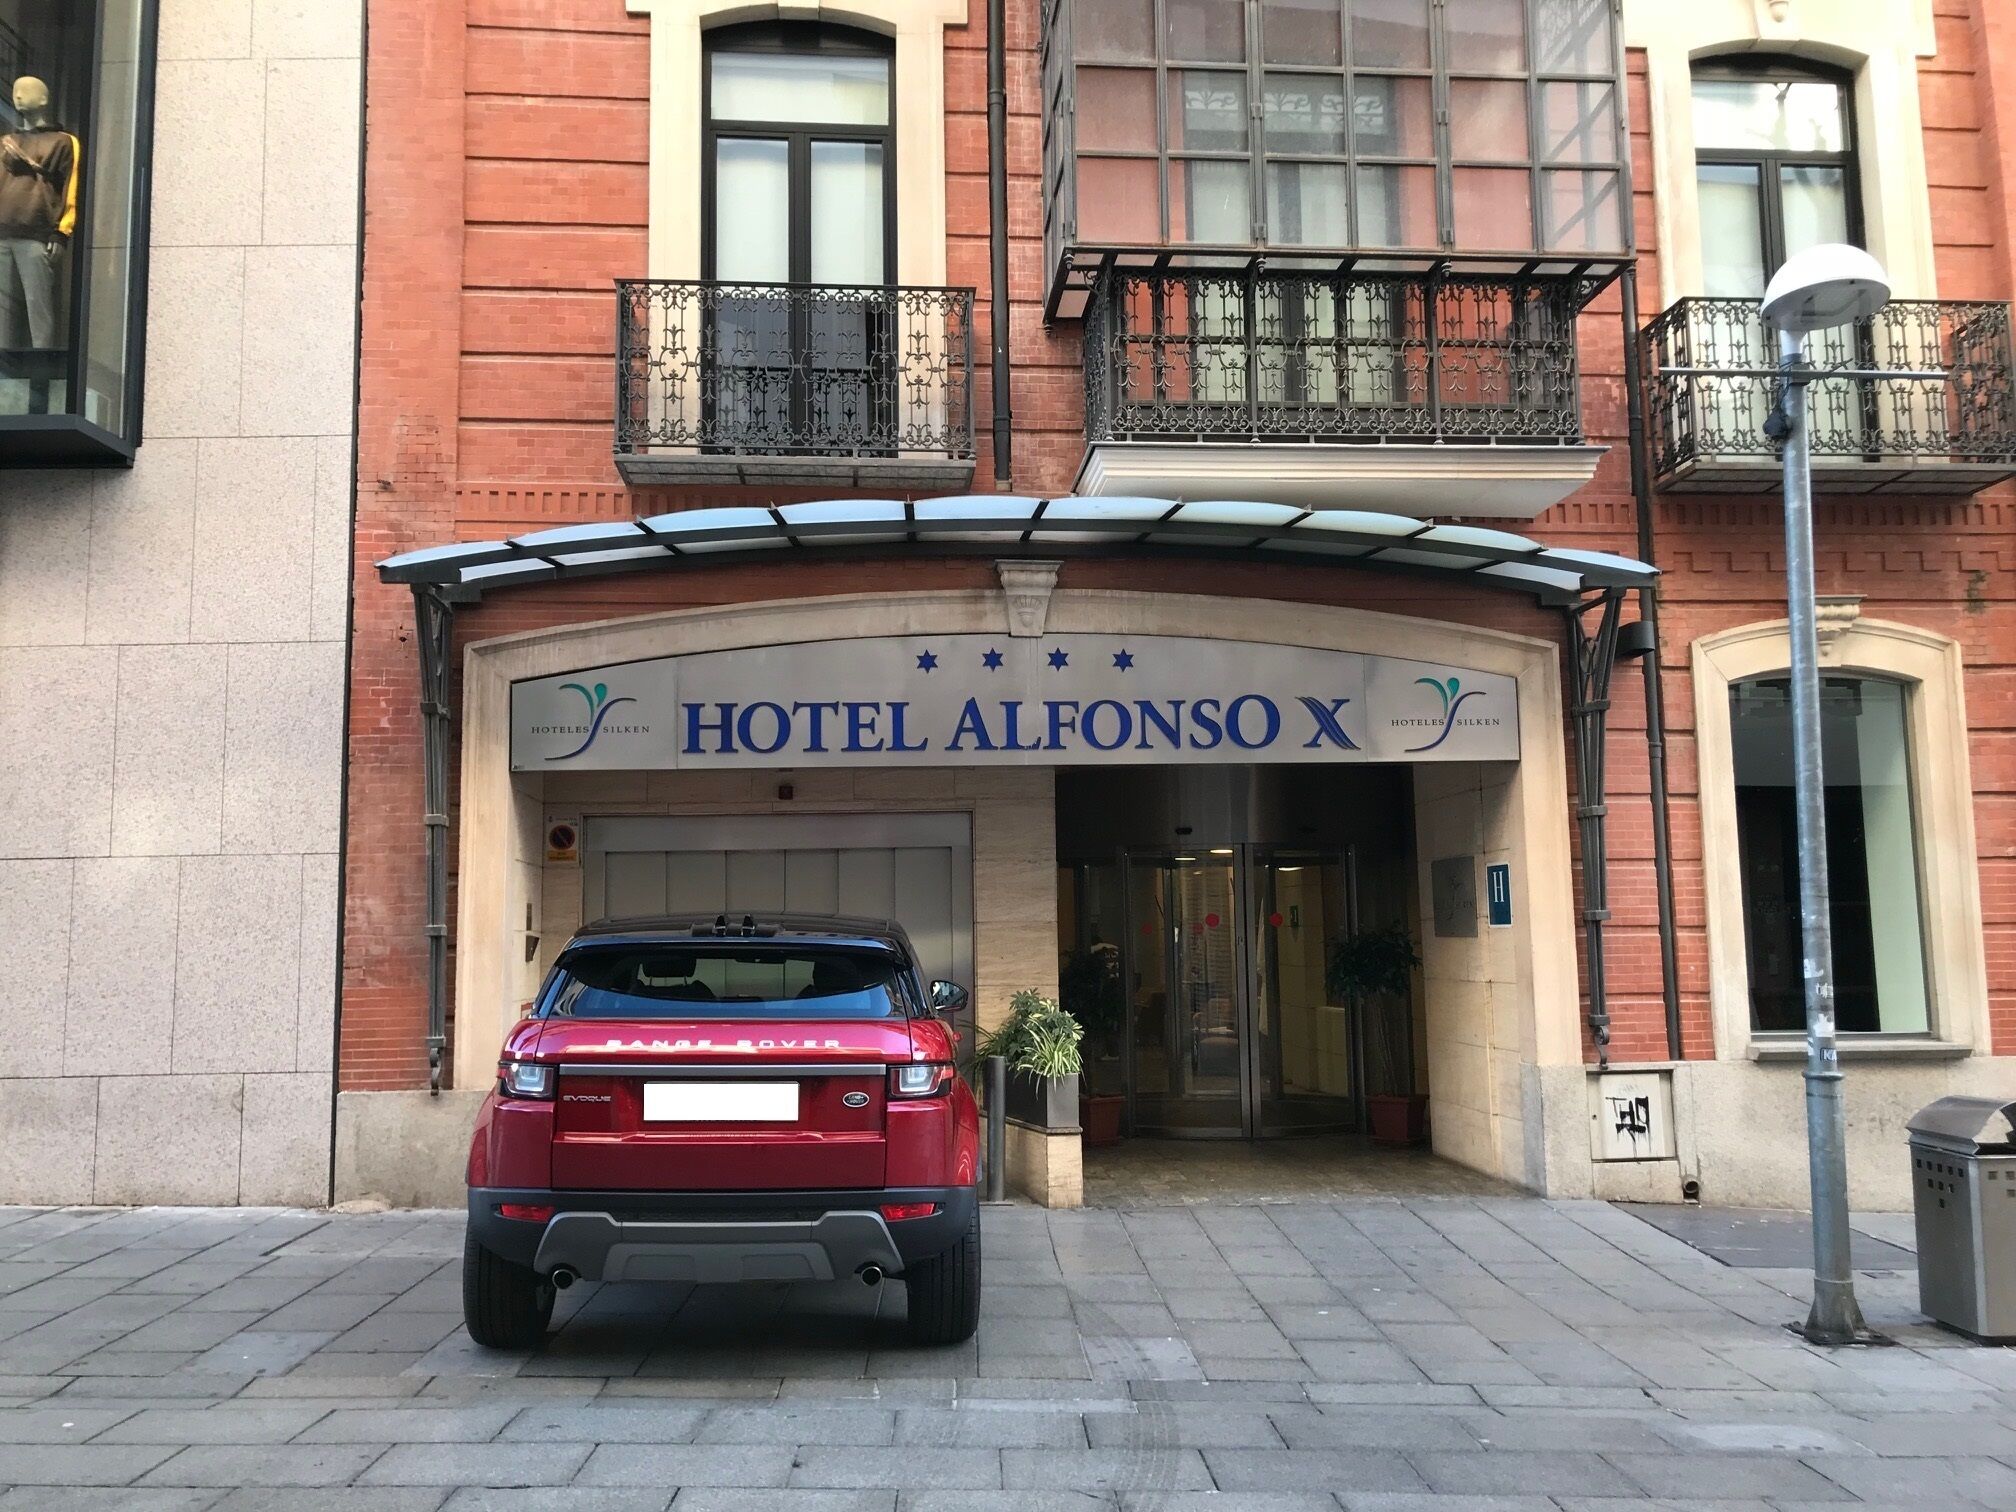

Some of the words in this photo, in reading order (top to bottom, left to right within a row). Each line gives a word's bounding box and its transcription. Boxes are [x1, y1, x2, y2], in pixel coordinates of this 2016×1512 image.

[681, 700, 928, 754] HOTEL
[945, 694, 1281, 752] ALFONSO
[1295, 696, 1361, 750] X
[1391, 718, 1445, 727] HOTELES
[1456, 718, 1501, 727] SILKEN
[531, 726, 590, 735] HOTELES
[603, 725, 651, 735] SILKEN
[1492, 870, 1505, 903] H
[606, 1039, 713, 1051] RANGE
[736, 1039, 841, 1050] ROVER
[562, 1094, 612, 1103] EVOQUE
